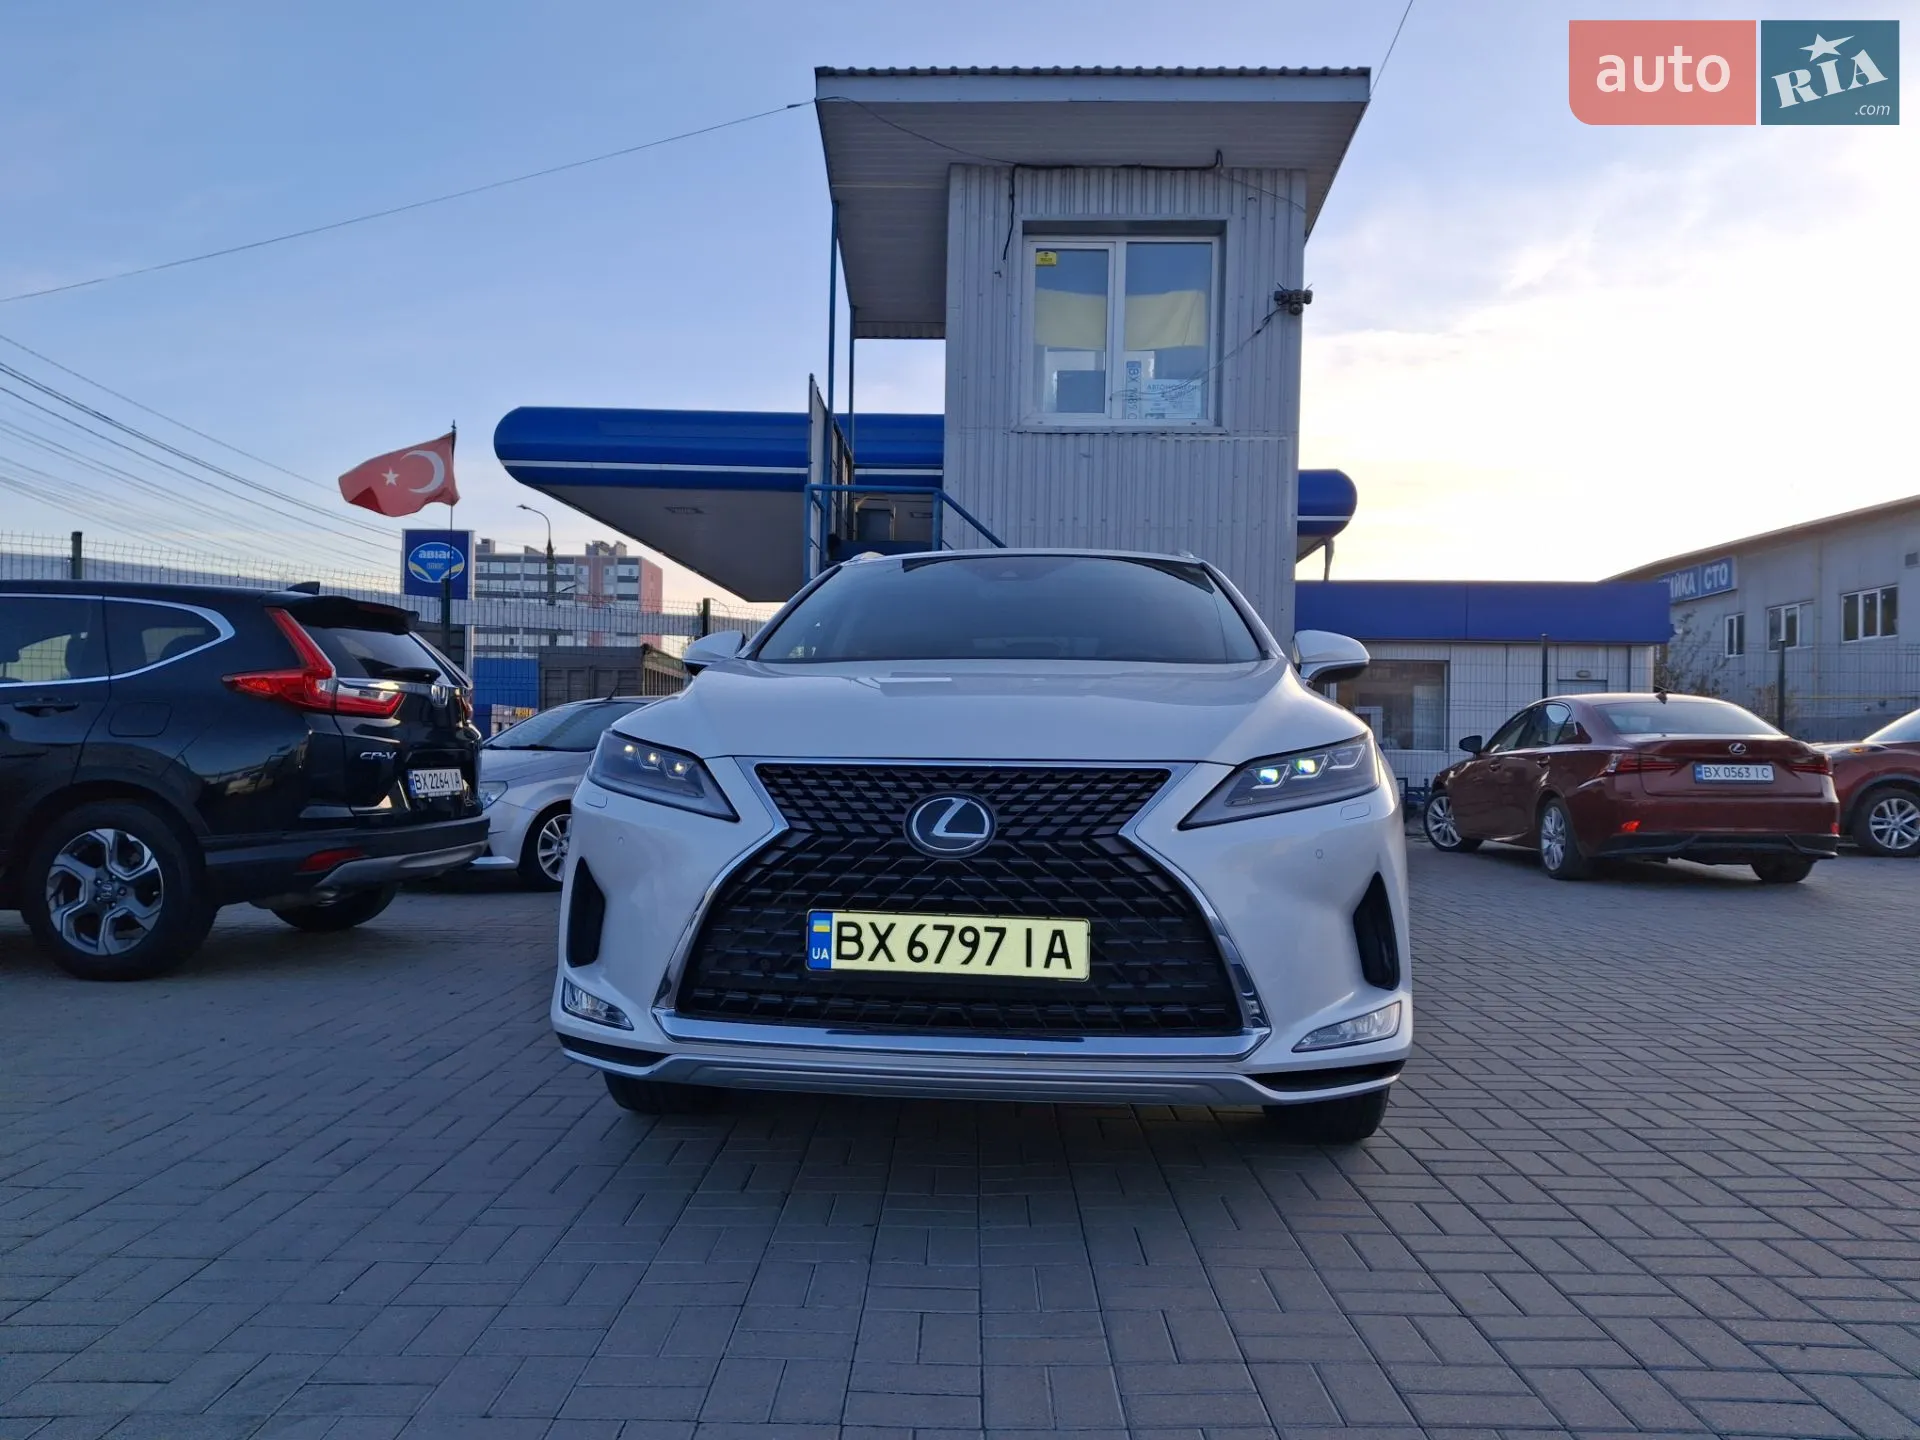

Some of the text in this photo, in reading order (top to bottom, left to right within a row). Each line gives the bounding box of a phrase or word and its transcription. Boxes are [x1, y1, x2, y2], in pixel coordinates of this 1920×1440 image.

[1704, 562, 1729, 590] СТО
[413, 773, 429, 790] BX
[428, 772, 449, 789] 2264
[1703, 766, 1769, 779] BX 0563 IC
[811, 947, 829, 960] UA
[835, 920, 1073, 970] BX 6797 IA
